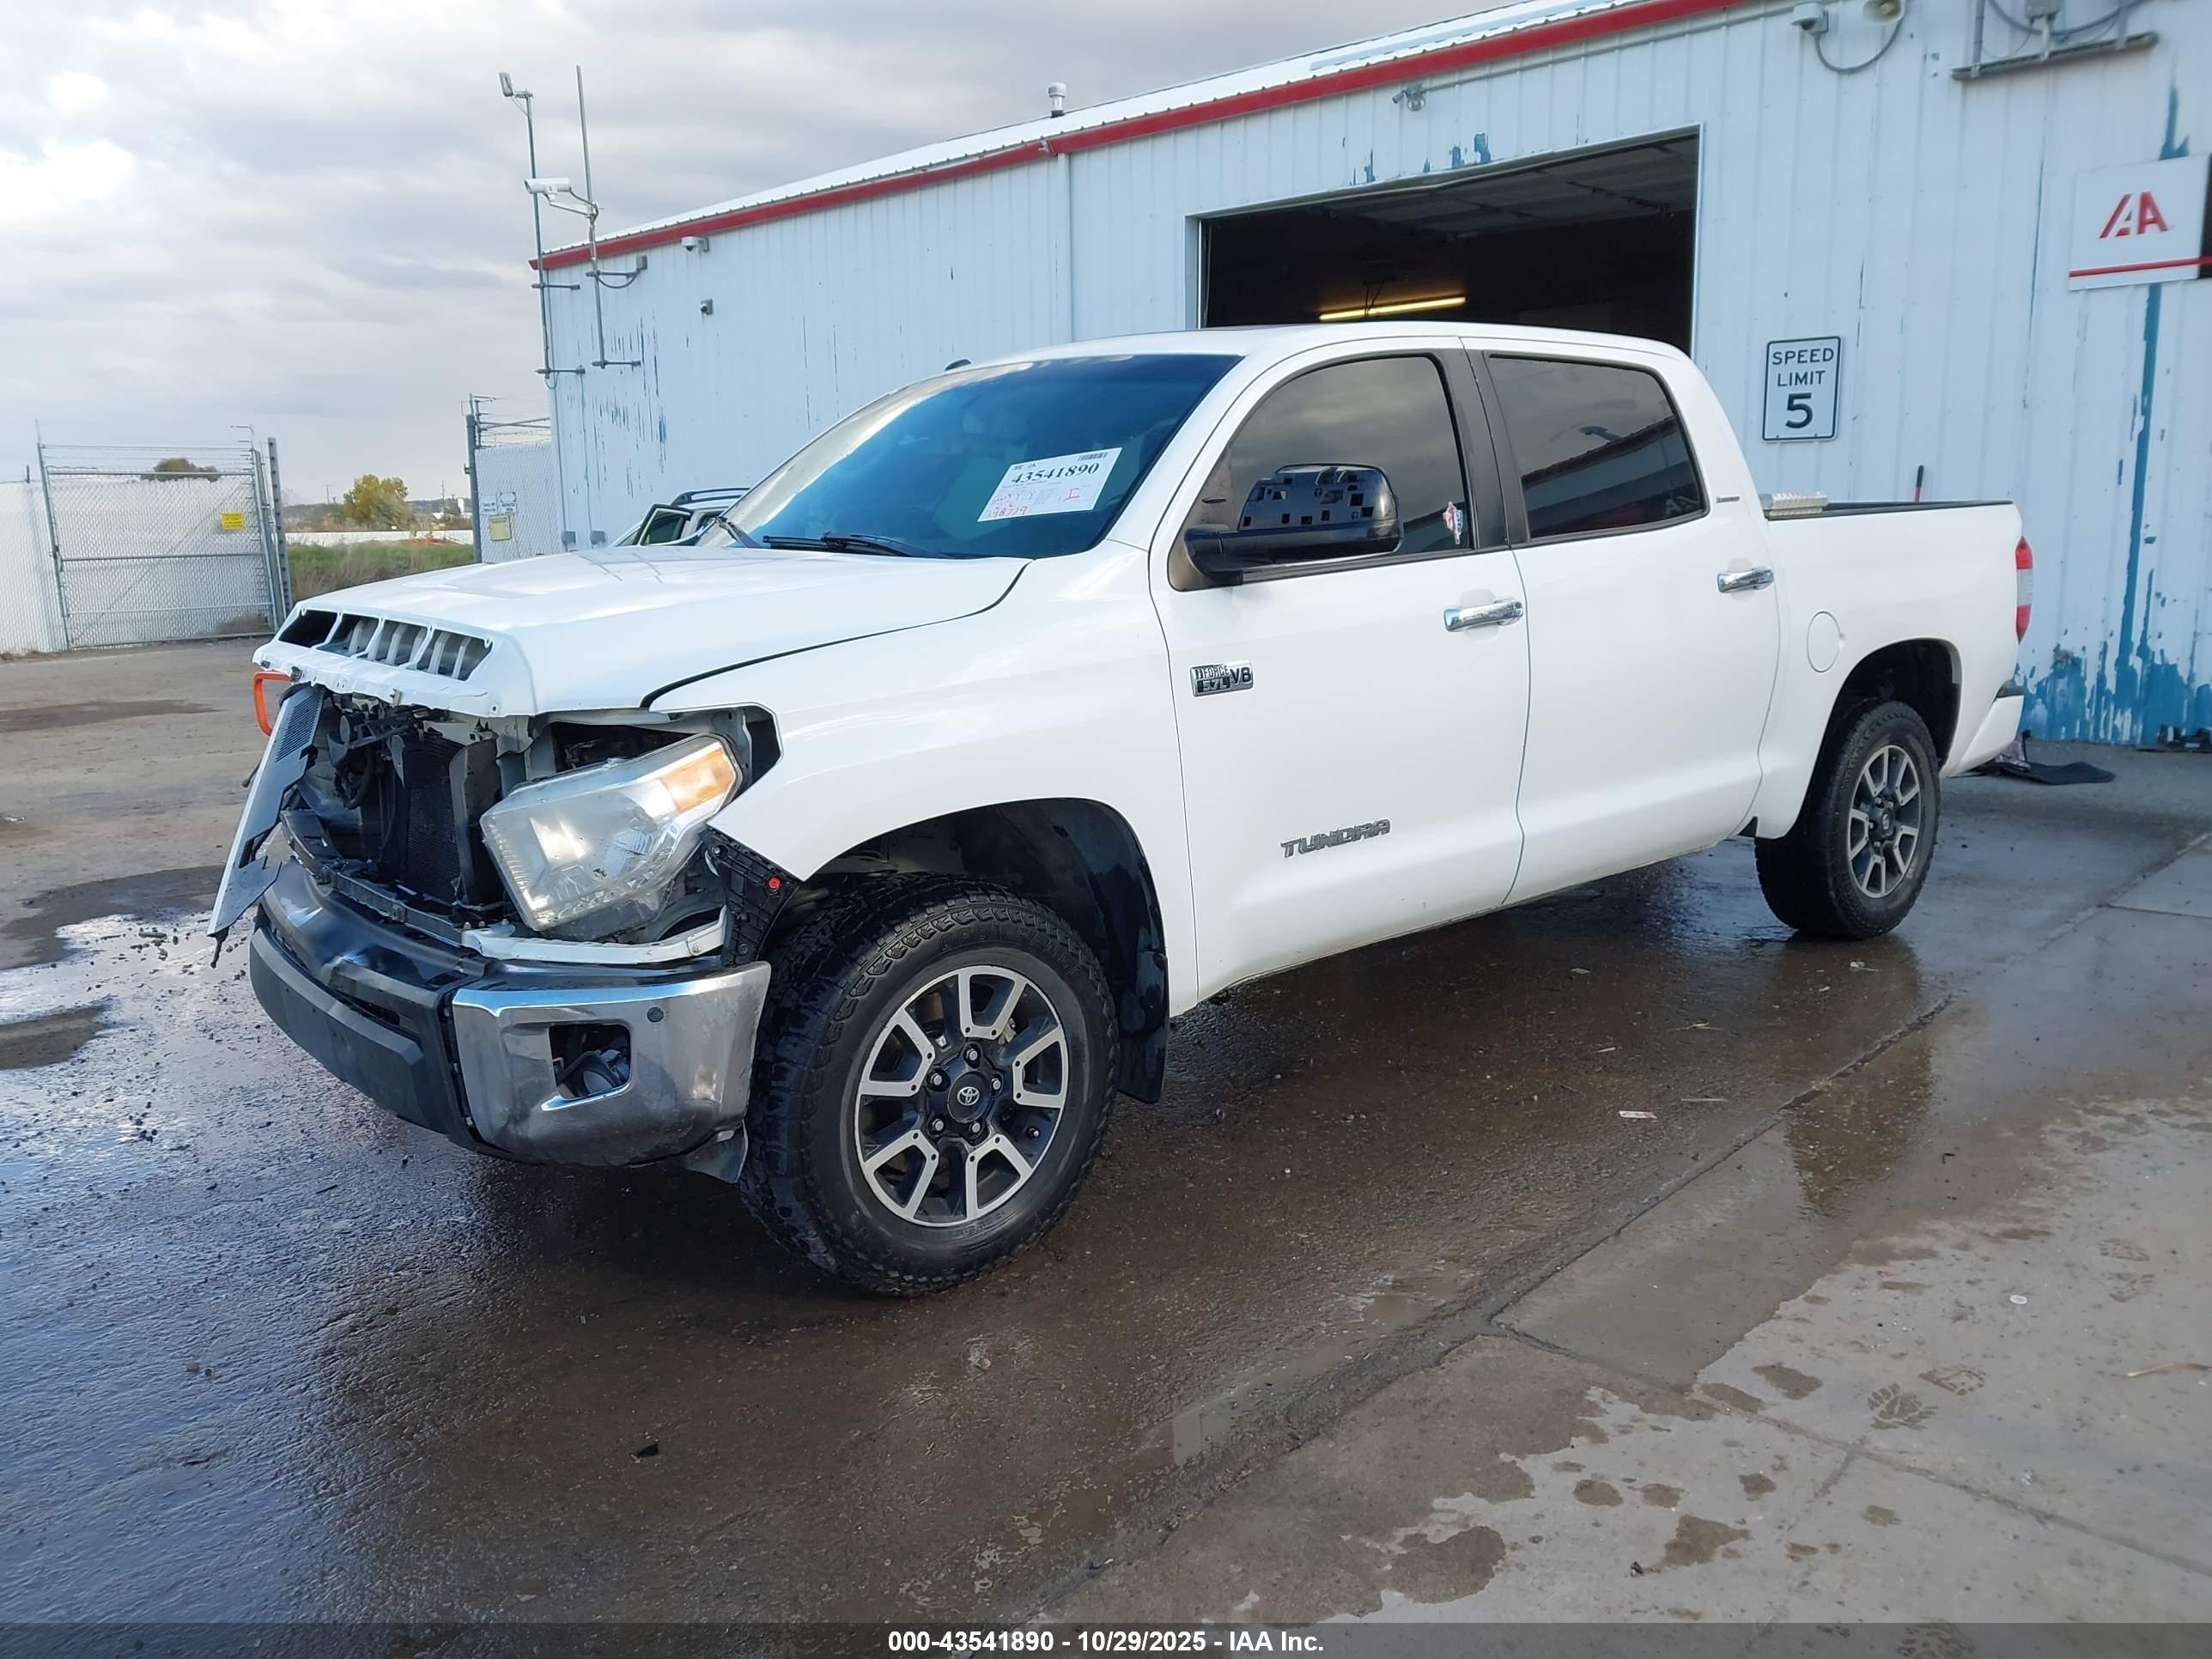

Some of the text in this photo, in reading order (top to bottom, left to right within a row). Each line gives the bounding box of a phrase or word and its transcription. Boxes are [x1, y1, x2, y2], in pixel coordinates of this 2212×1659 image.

[1772, 348, 1834, 365] SPEED
[1778, 370, 1826, 386] LIMIT
[1785, 392, 1814, 428] 5
[1011, 462, 1100, 483] 43541890
[1230, 667, 1251, 684] V8
[1280, 818, 1391, 858] TUNDRA
